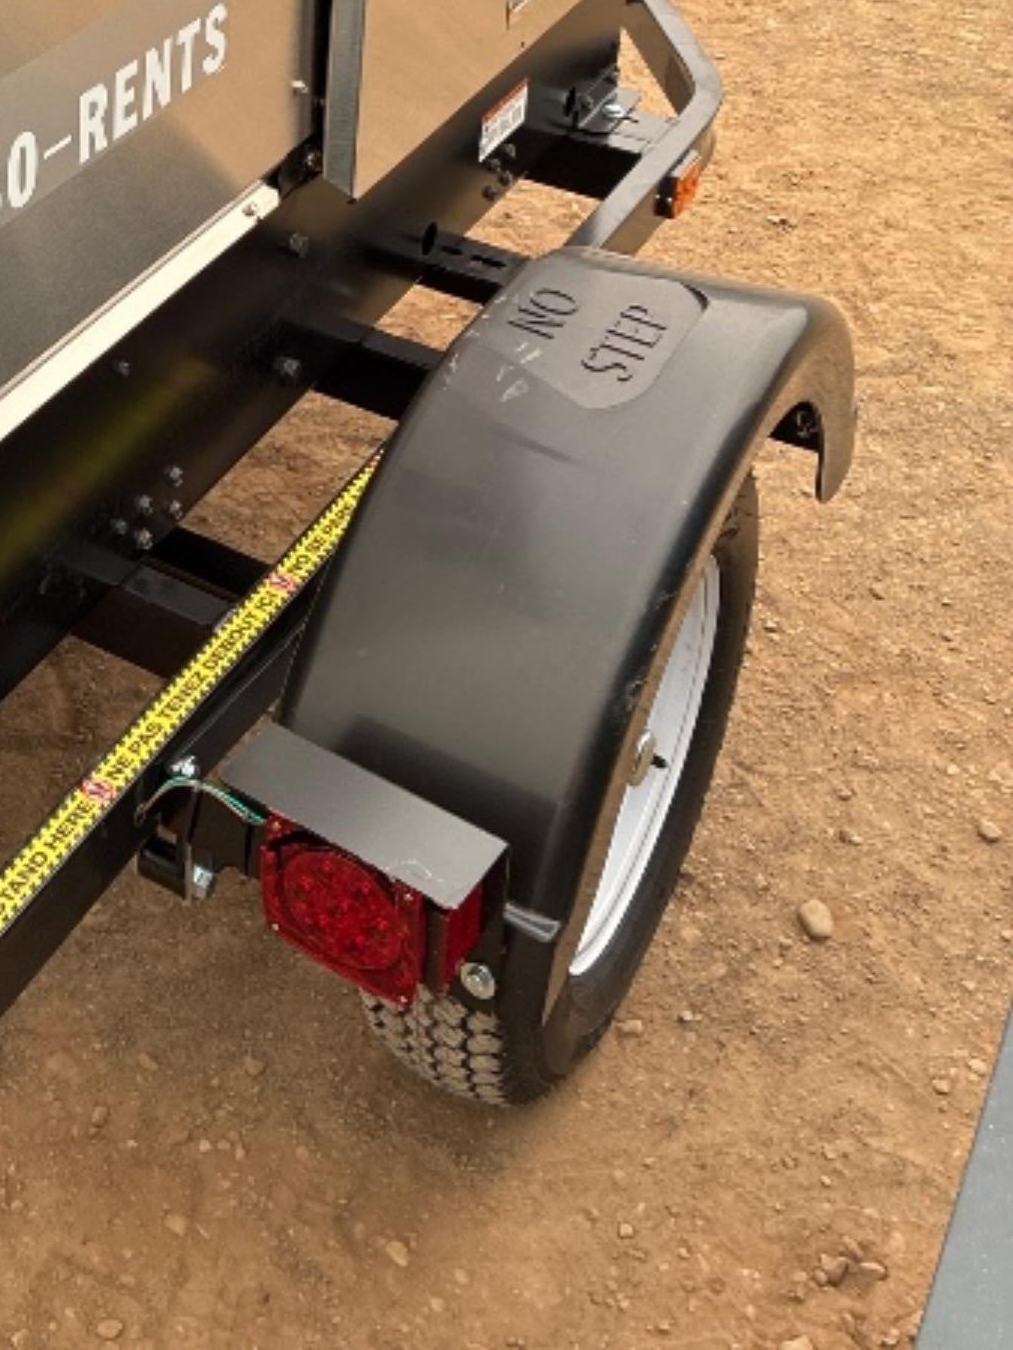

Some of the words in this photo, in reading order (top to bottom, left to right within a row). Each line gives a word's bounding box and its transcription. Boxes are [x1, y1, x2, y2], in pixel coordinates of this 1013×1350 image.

[508, 287, 580, 340] NO
[581, 304, 667, 382] STEP
[127, 719, 162, 756] PAS
[43, 796, 97, 854] HERE
